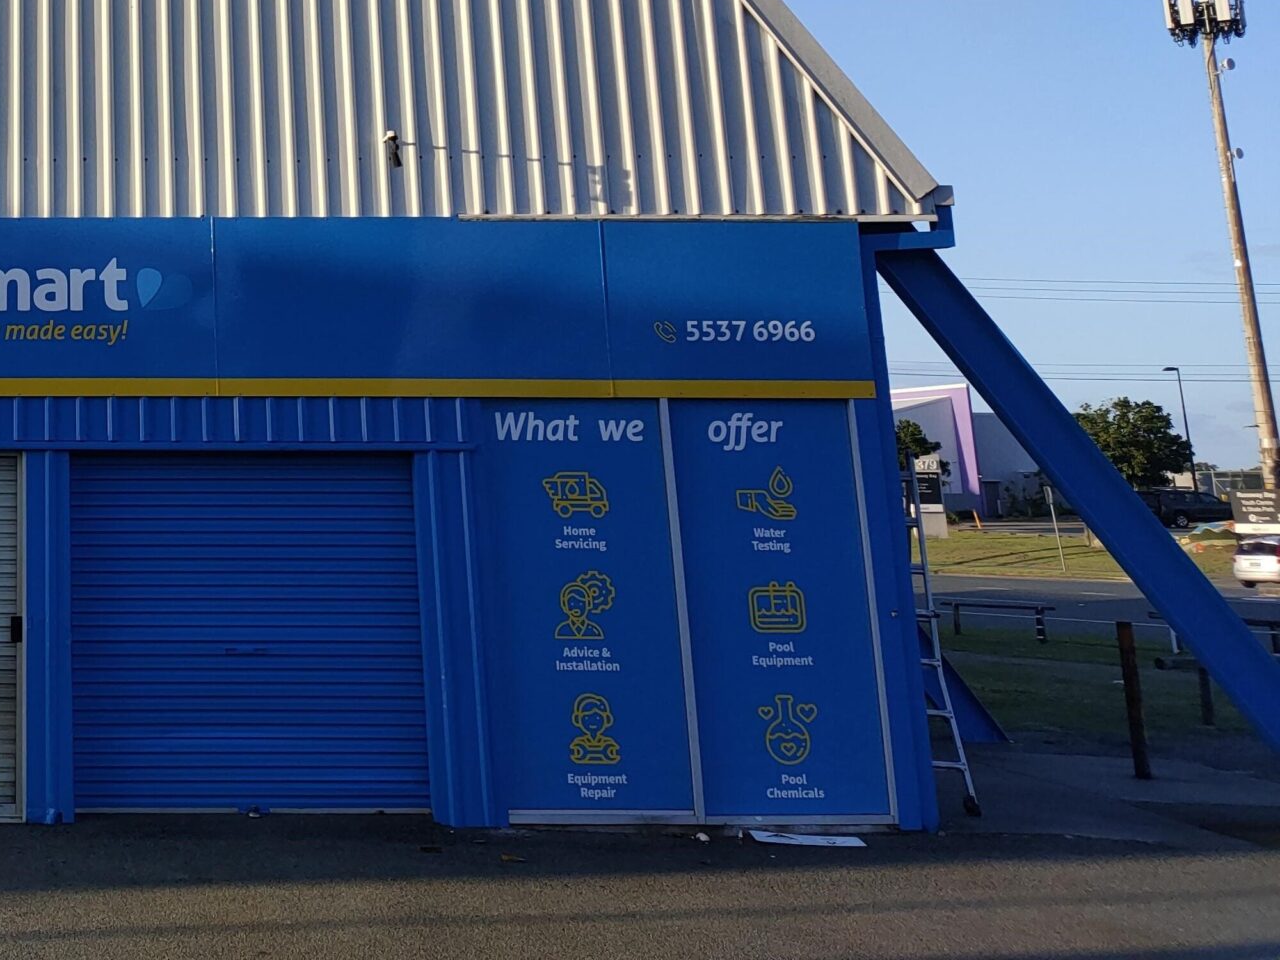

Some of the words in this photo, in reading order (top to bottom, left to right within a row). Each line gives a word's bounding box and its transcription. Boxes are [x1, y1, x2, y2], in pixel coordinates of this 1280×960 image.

[5, 320, 65, 340] made
[71, 320, 128, 345] easy!
[687, 321, 746, 341] 5537
[753, 320, 815, 341] 6966
[495, 412, 579, 441] What
[599, 420, 643, 441] we
[708, 413, 783, 450] offer
[917, 459, 937, 470] 379
[563, 525, 596, 536] Home
[753, 527, 786, 538] Water
[555, 538, 607, 551] Servicing
[751, 540, 791, 553] Testing
[562, 646, 599, 658] Advice
[601, 647, 612, 658] &
[769, 642, 794, 652] Pool
[556, 660, 620, 671] Installation
[752, 655, 813, 667] Equipment
[567, 773, 628, 786] Equipment
[781, 774, 808, 785] Pool
[580, 787, 617, 800] Repair
[767, 787, 826, 799] Chemicals
